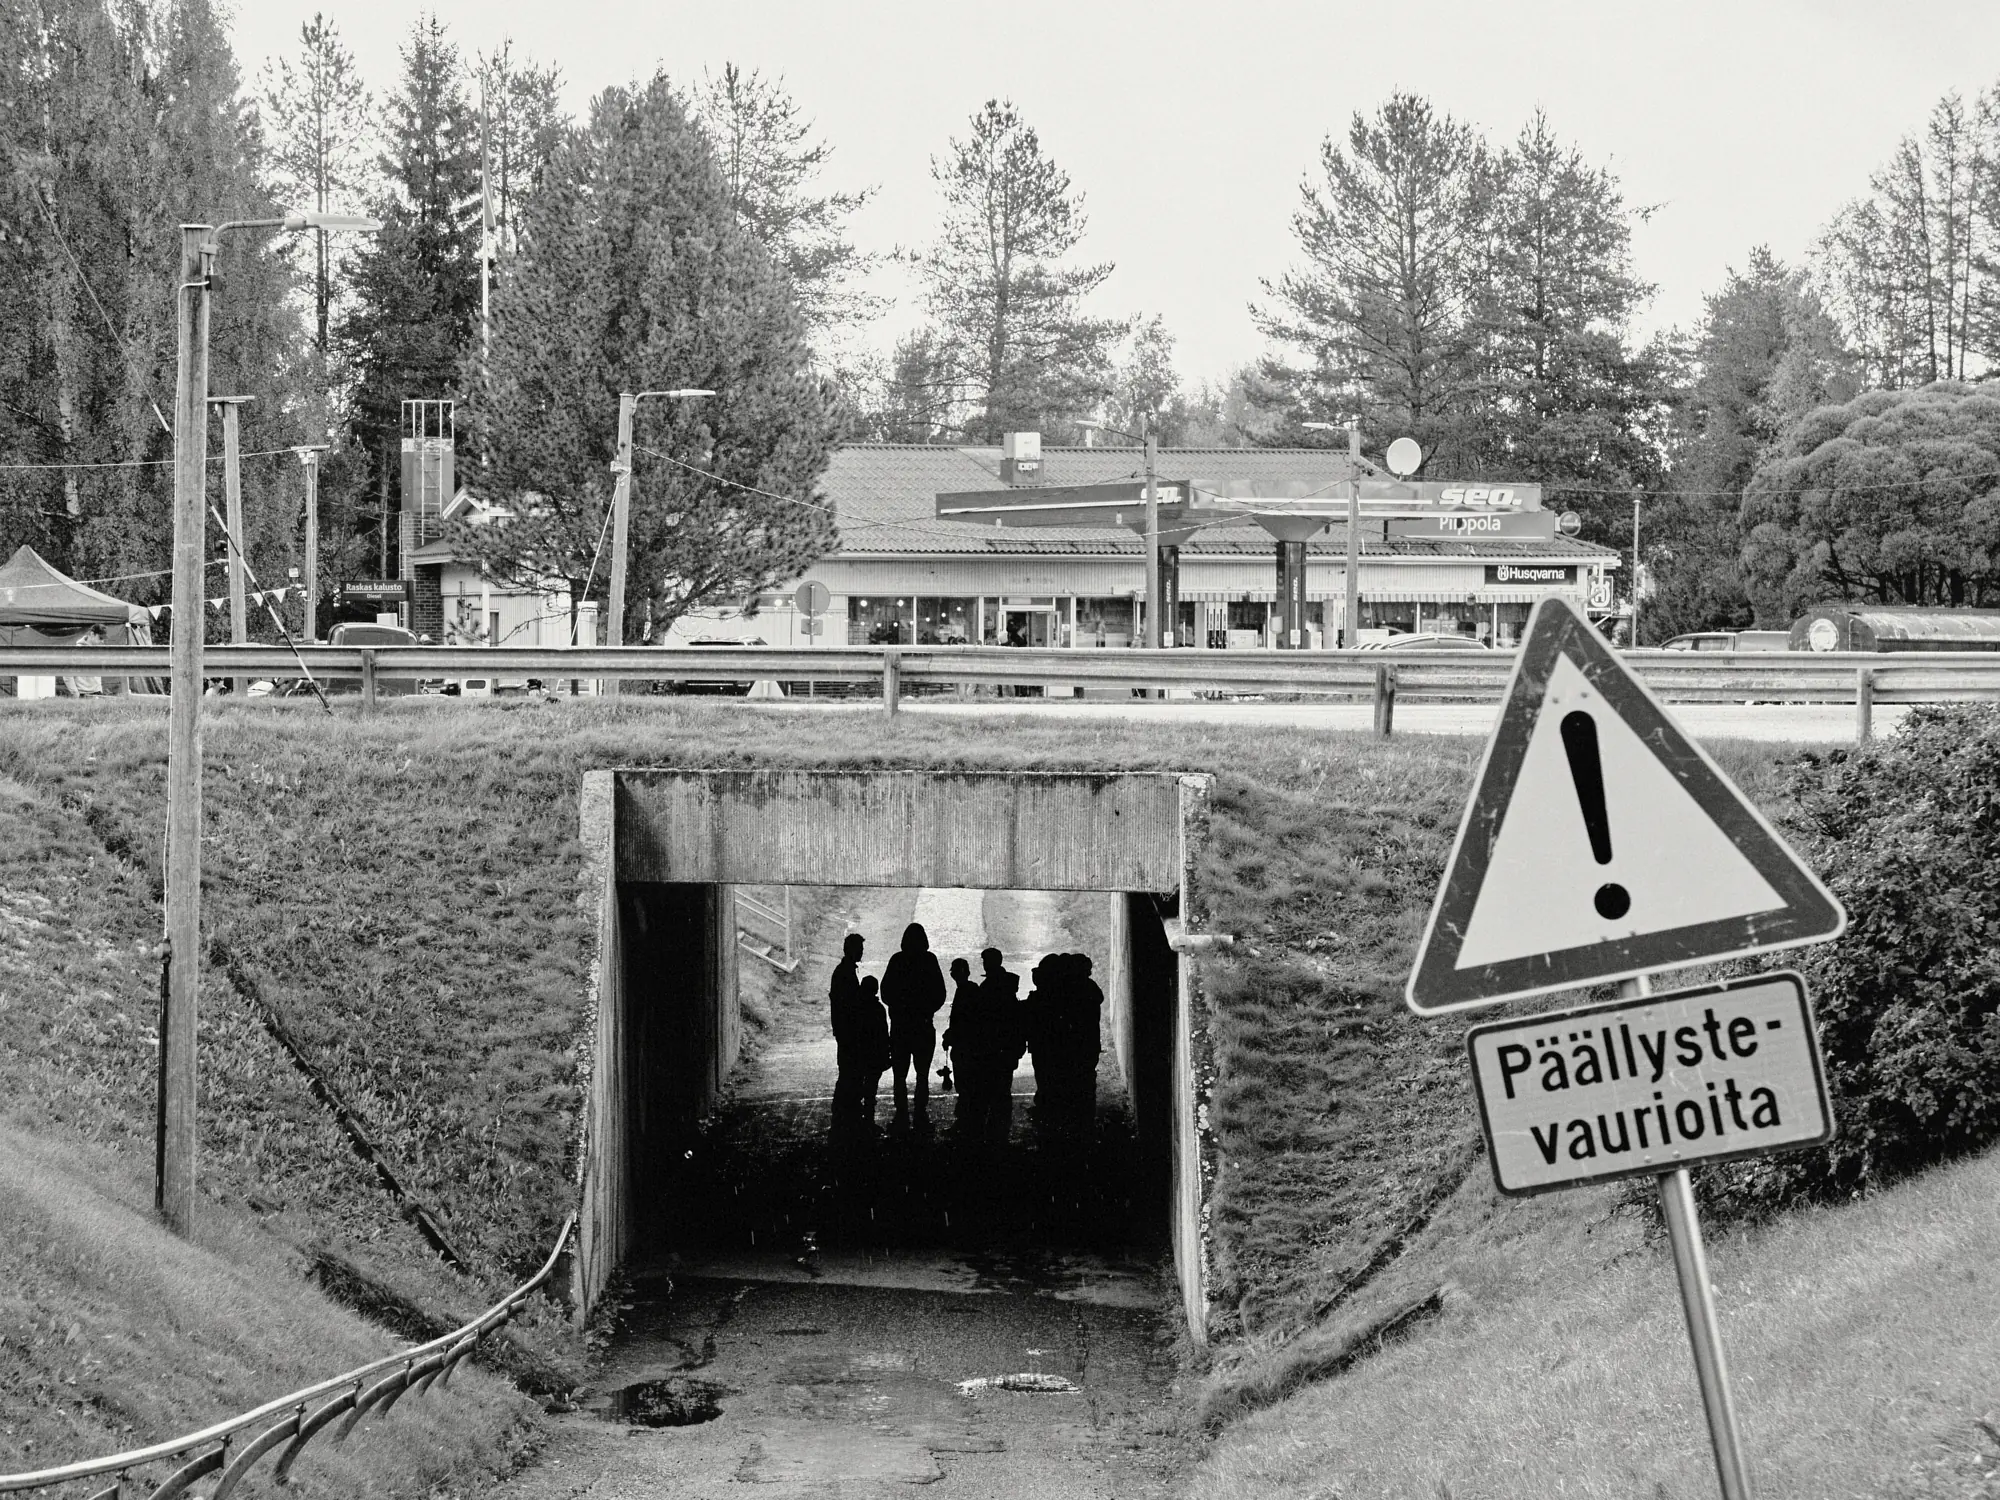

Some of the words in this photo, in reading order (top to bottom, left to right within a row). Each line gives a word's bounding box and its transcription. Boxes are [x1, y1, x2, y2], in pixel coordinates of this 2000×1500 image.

[346, 582, 373, 591] Raskas
[373, 582, 403, 591] kalusto
[1509, 566, 1566, 581] Husqvarna
[1497, 1008, 1782, 1100] Päällyste-
[1530, 1078, 1782, 1166] vaurioita
